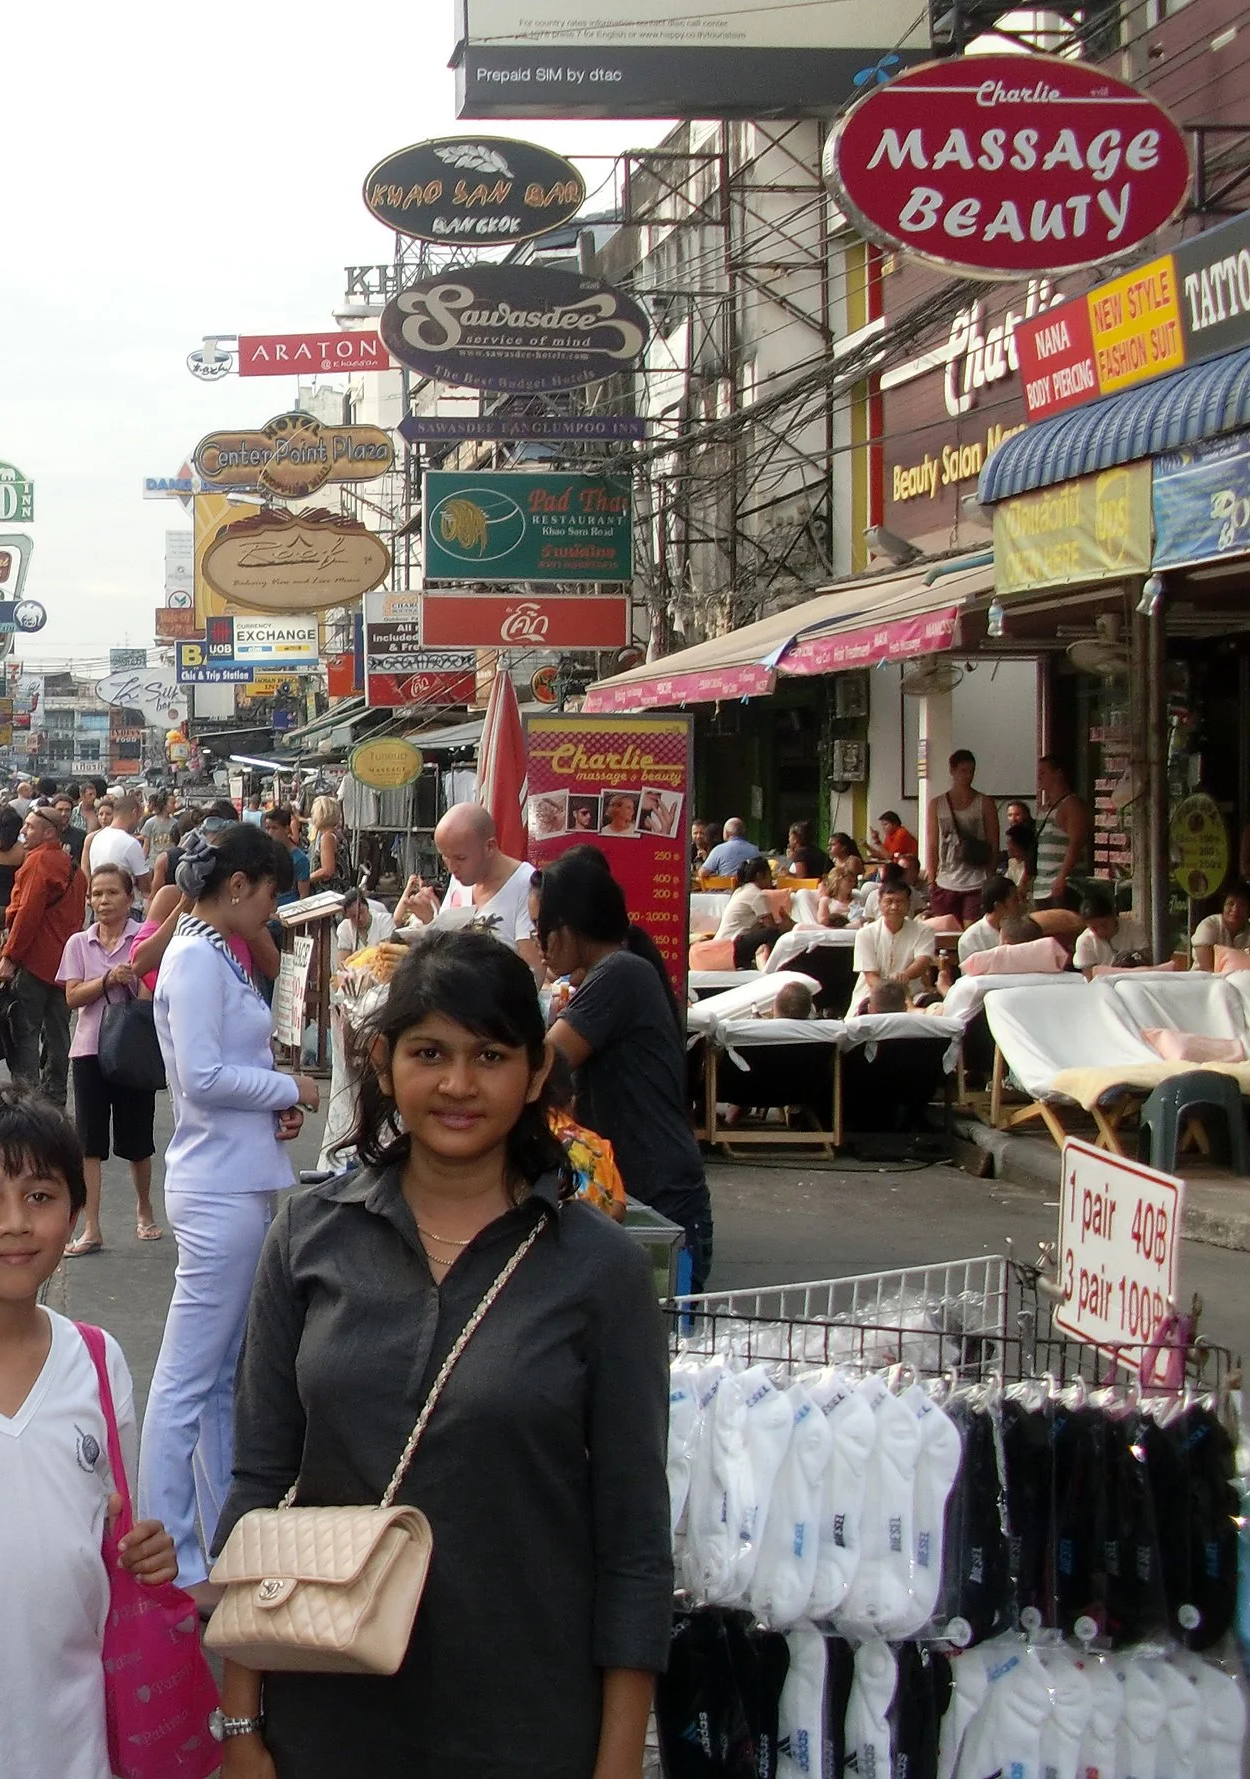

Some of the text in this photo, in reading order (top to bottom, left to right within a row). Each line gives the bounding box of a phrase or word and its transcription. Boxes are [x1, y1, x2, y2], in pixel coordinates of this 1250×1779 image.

[476, 68, 622, 84] Prepaid SIM by dtac
[976, 79, 1061, 107] Charlie
[866, 127, 1160, 182] MASSAGE
[453, 180, 513, 208] SAN
[524, 180, 581, 207] BAR
[898, 183, 1130, 242] BEAUTY
[432, 215, 521, 234] BANGKOK
[1093, 270, 1172, 334] NEW STYLE
[397, 284, 642, 359] Sawasdee
[251, 339, 378, 362] ARATON
[465, 335, 591, 347] service of mind
[1035, 320, 1071, 360] NANA
[1098, 322, 1177, 383] FASHION SUIT
[434, 364, 458, 382] The
[462, 369, 492, 386] Best
[1026, 359, 1094, 410] BODY PIERCING
[612, 422, 640, 434] INN
[200, 435, 388, 477] Center Point Plaza
[893, 442, 980, 502] Beauty Salon
[528, 486, 574, 513] Pad
[532, 514, 623, 526] RESTAURANT
[236, 630, 316, 641] EXCHANGE
[372, 633, 419, 642] Included
[396, 624, 412, 632] All
[209, 644, 232, 654] UOB
[388, 642, 419, 651] & Fre
[181, 670, 249, 682] Chic & Trip Station
[551, 743, 655, 775] Charlie
[575, 771, 628, 786] massage
[640, 769, 682, 786] beauty
[654, 851, 671, 861] 250
[652, 873, 671, 883] 400
[653, 889, 671, 899] 200
[1069, 1169, 1076, 1223] 1
[1081, 1183, 1116, 1244] pair
[1064, 1248, 1074, 1301] 3
[1077, 1264, 1113, 1322] pair
